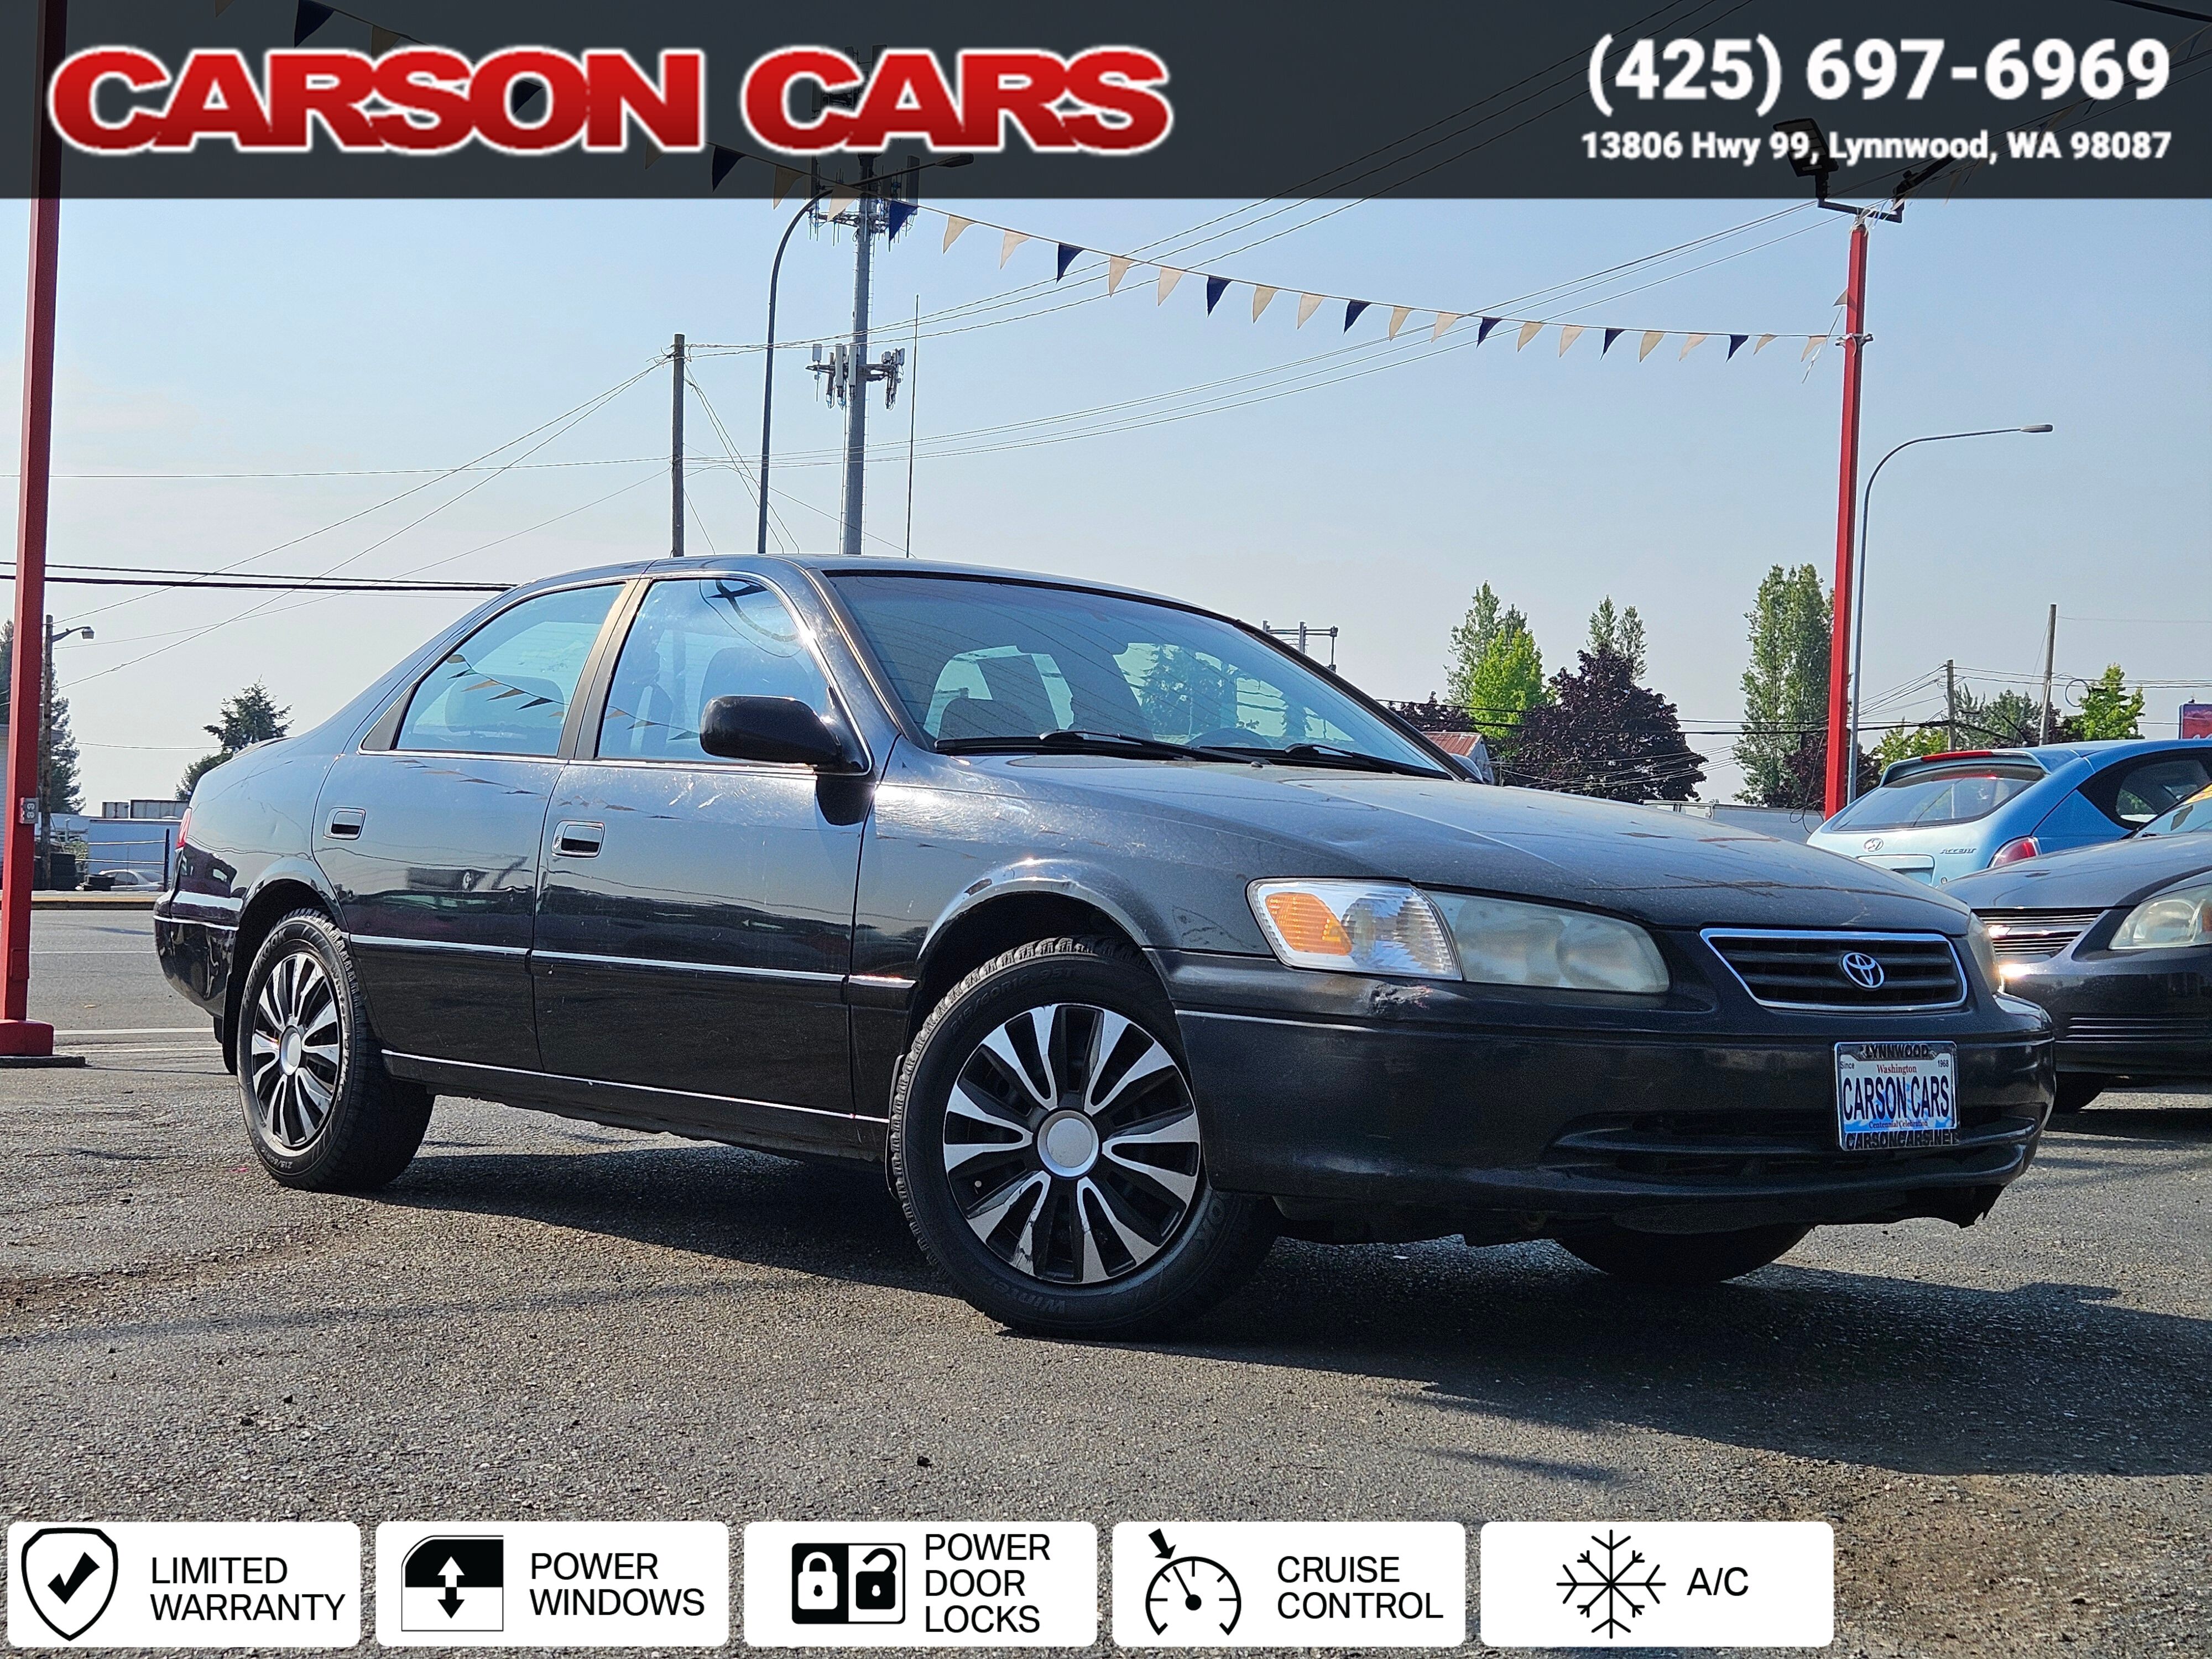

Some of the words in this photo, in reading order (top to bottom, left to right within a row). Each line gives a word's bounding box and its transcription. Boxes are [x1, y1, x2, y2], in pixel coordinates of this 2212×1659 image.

[1865, 1044, 1929, 1059] LYNNWOOD
[1840, 1061, 1855, 1070] Since
[1876, 1064, 1917, 1076] Washington
[1843, 1077, 1907, 1120] CARSON
[1911, 1075, 1949, 1118] CARS
[1899, 1119, 1928, 1128] Celebration
